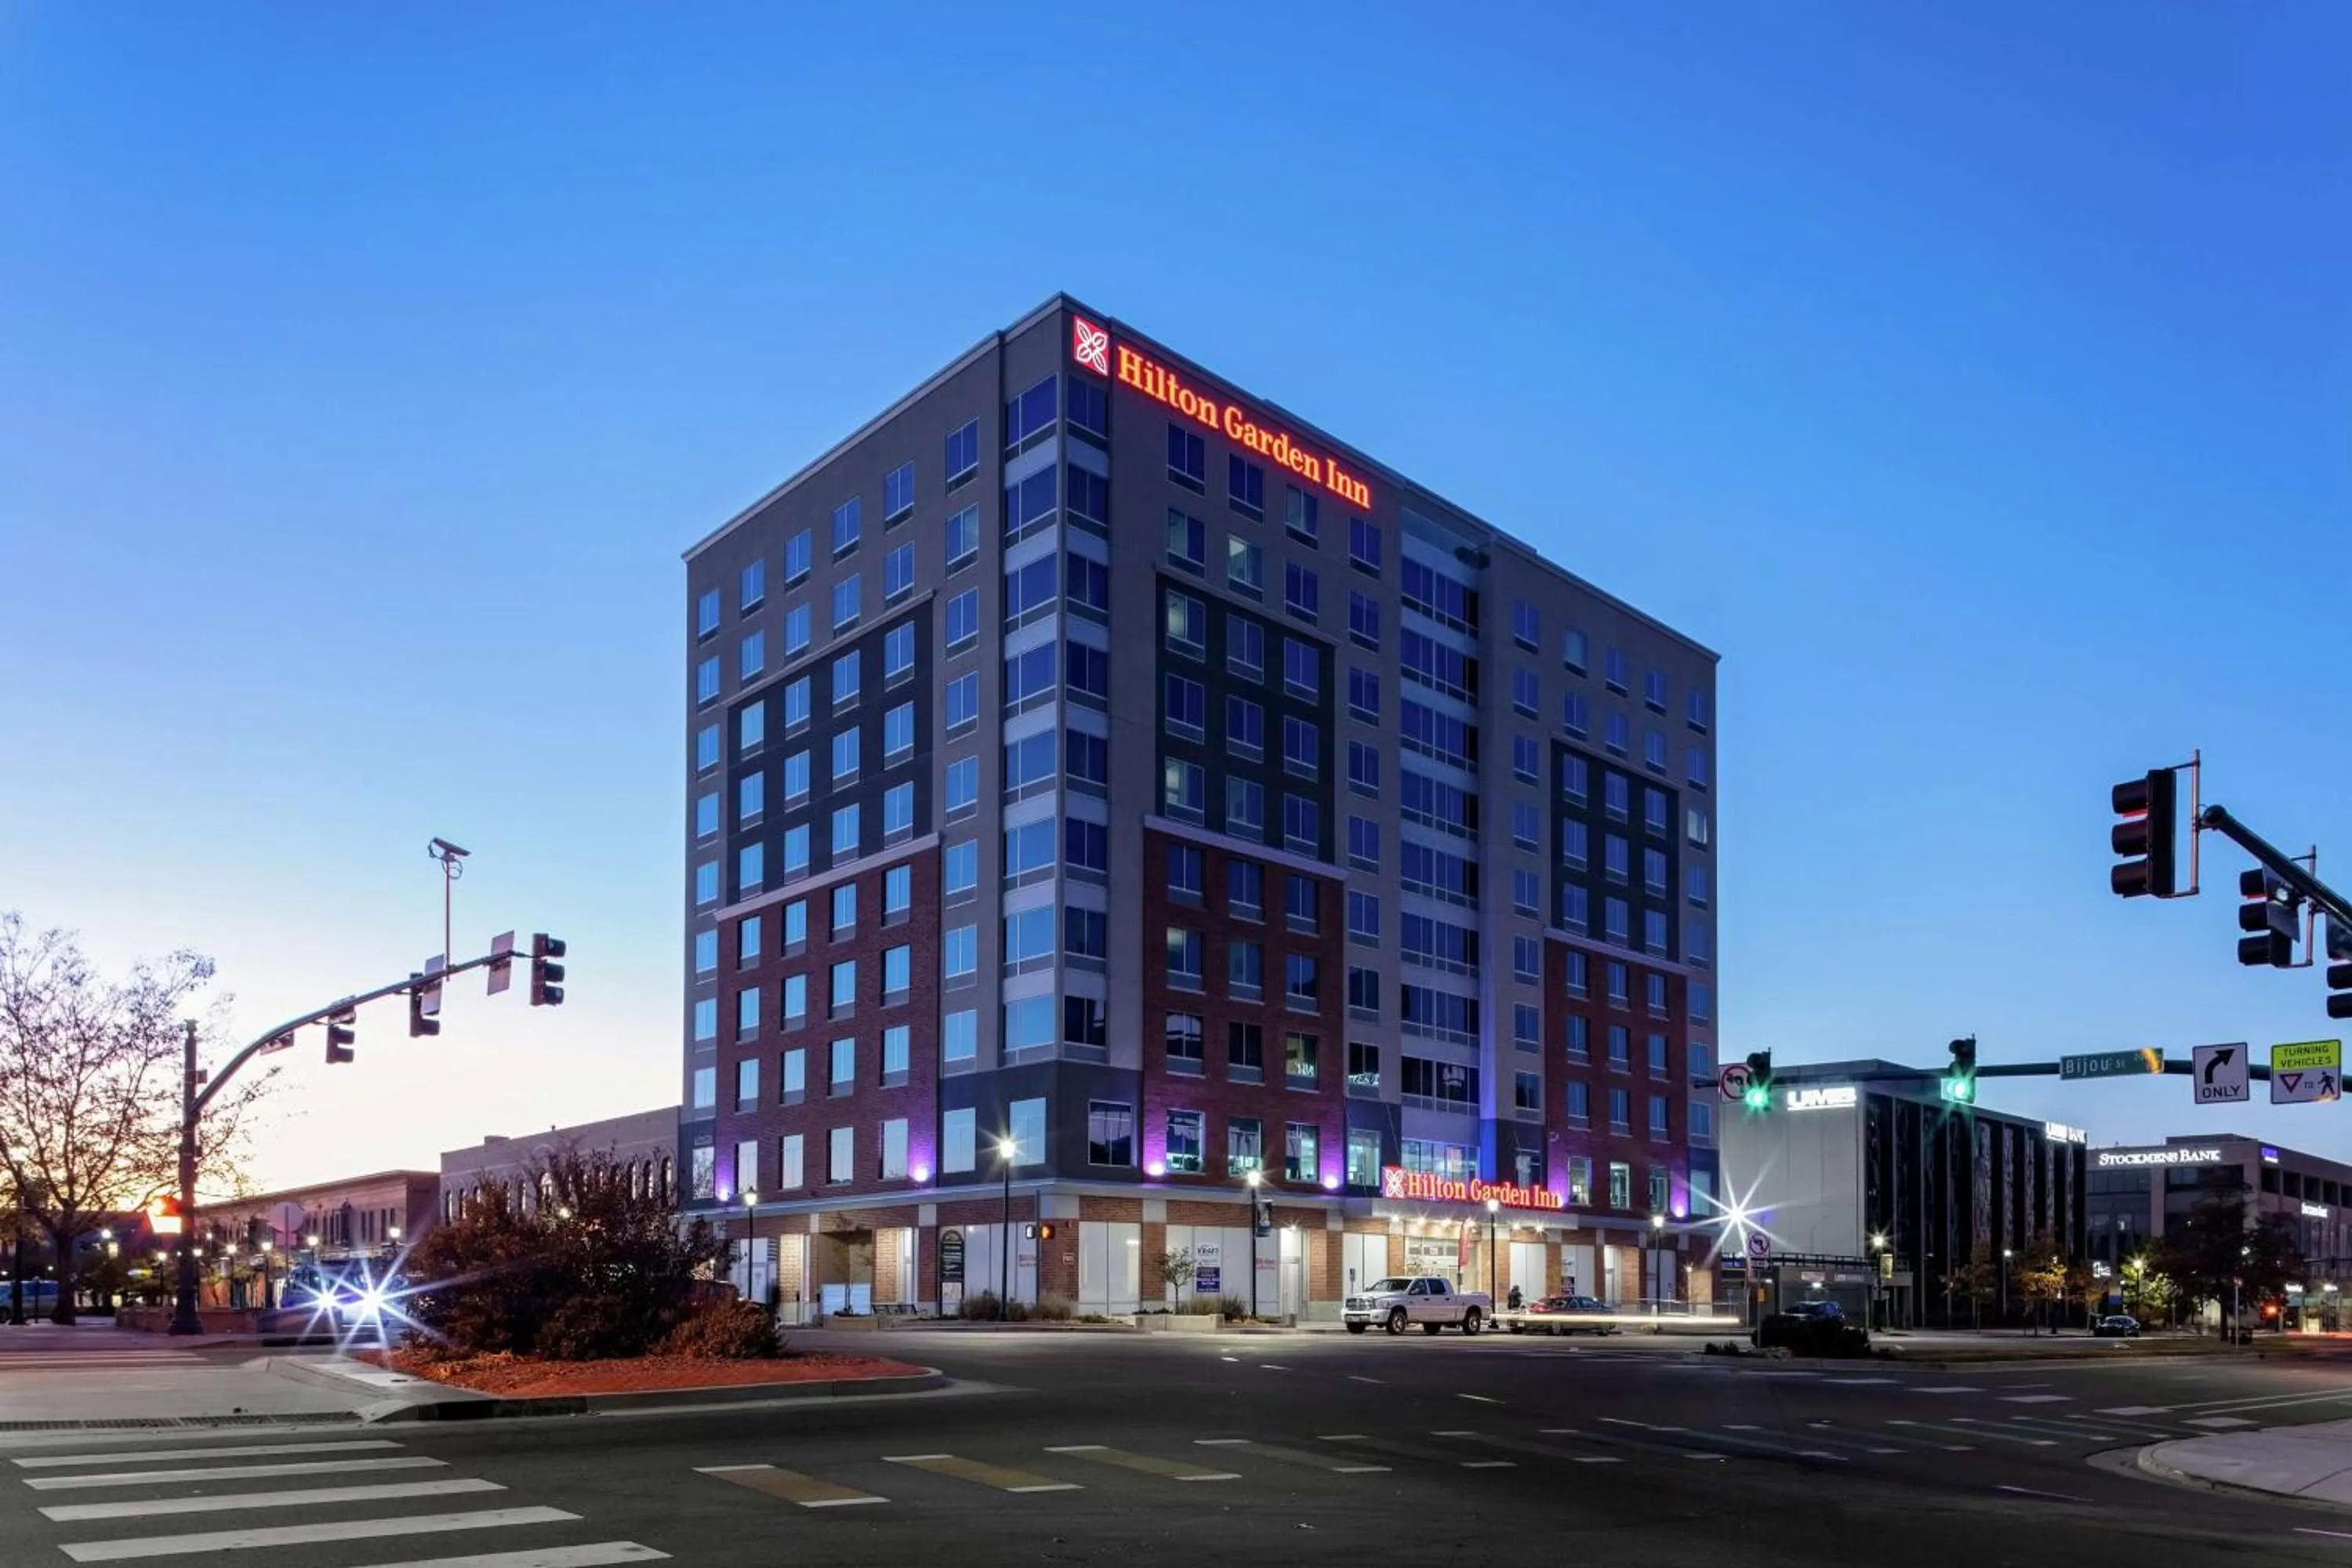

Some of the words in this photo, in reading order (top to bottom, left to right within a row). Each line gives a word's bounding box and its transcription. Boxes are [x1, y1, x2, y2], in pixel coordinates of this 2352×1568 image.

[1118, 345, 1219, 430] Hilton
[1223, 405, 1321, 483] Garden
[1326, 457, 1371, 509] Inn
[2284, 1044, 2328, 1057] TURNING
[2280, 1056, 2332, 1068] VEHICLES
[2202, 1084, 2241, 1098] ONLY
[2099, 1151, 2178, 1166] STOCKMENS
[2180, 1149, 2221, 1162] BANK
[1406, 1172, 1465, 1200] Hilton
[1470, 1178, 1530, 1206] Garden
[1533, 1185, 1563, 1209] Inn
